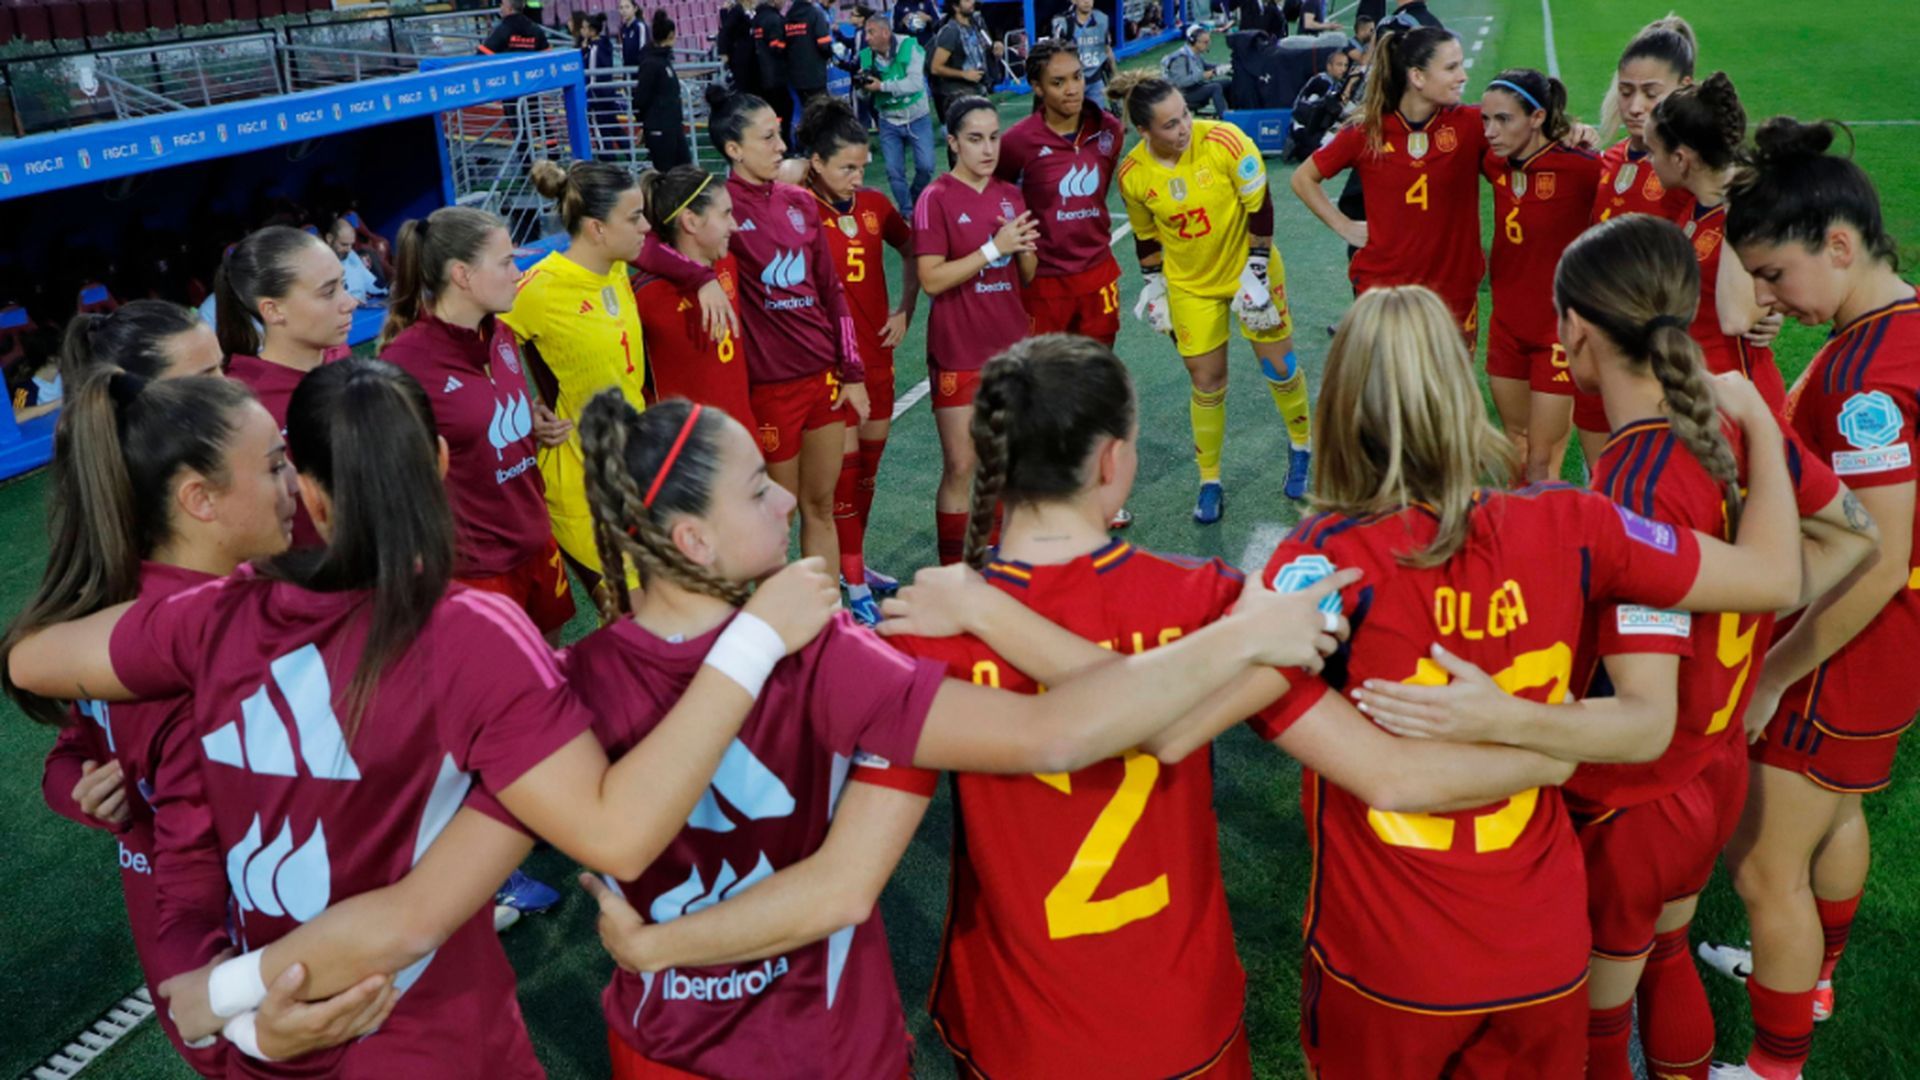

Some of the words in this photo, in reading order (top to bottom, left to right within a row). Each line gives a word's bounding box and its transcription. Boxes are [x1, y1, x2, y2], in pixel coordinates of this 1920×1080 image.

[24, 156, 64, 175] FIGC.IT
[102, 143, 139, 160] FIGC.IT
[172, 130, 206, 147] FIGC.IT
[237, 119, 268, 135] FIGC.IT
[1261, 125, 1280, 135] Rai
[1405, 173, 1428, 211] 4
[1056, 208, 1100, 221] Iberdrola
[1169, 207, 1212, 239] 23
[1505, 206, 1524, 244] 6
[846, 246, 866, 282] 5
[764, 296, 815, 310] Iberdrola
[619, 330, 635, 375] 1
[1435, 579, 1529, 640] OLGA
[1034, 750, 1171, 940] 2
[662, 956, 790, 1002] Iberdrola
